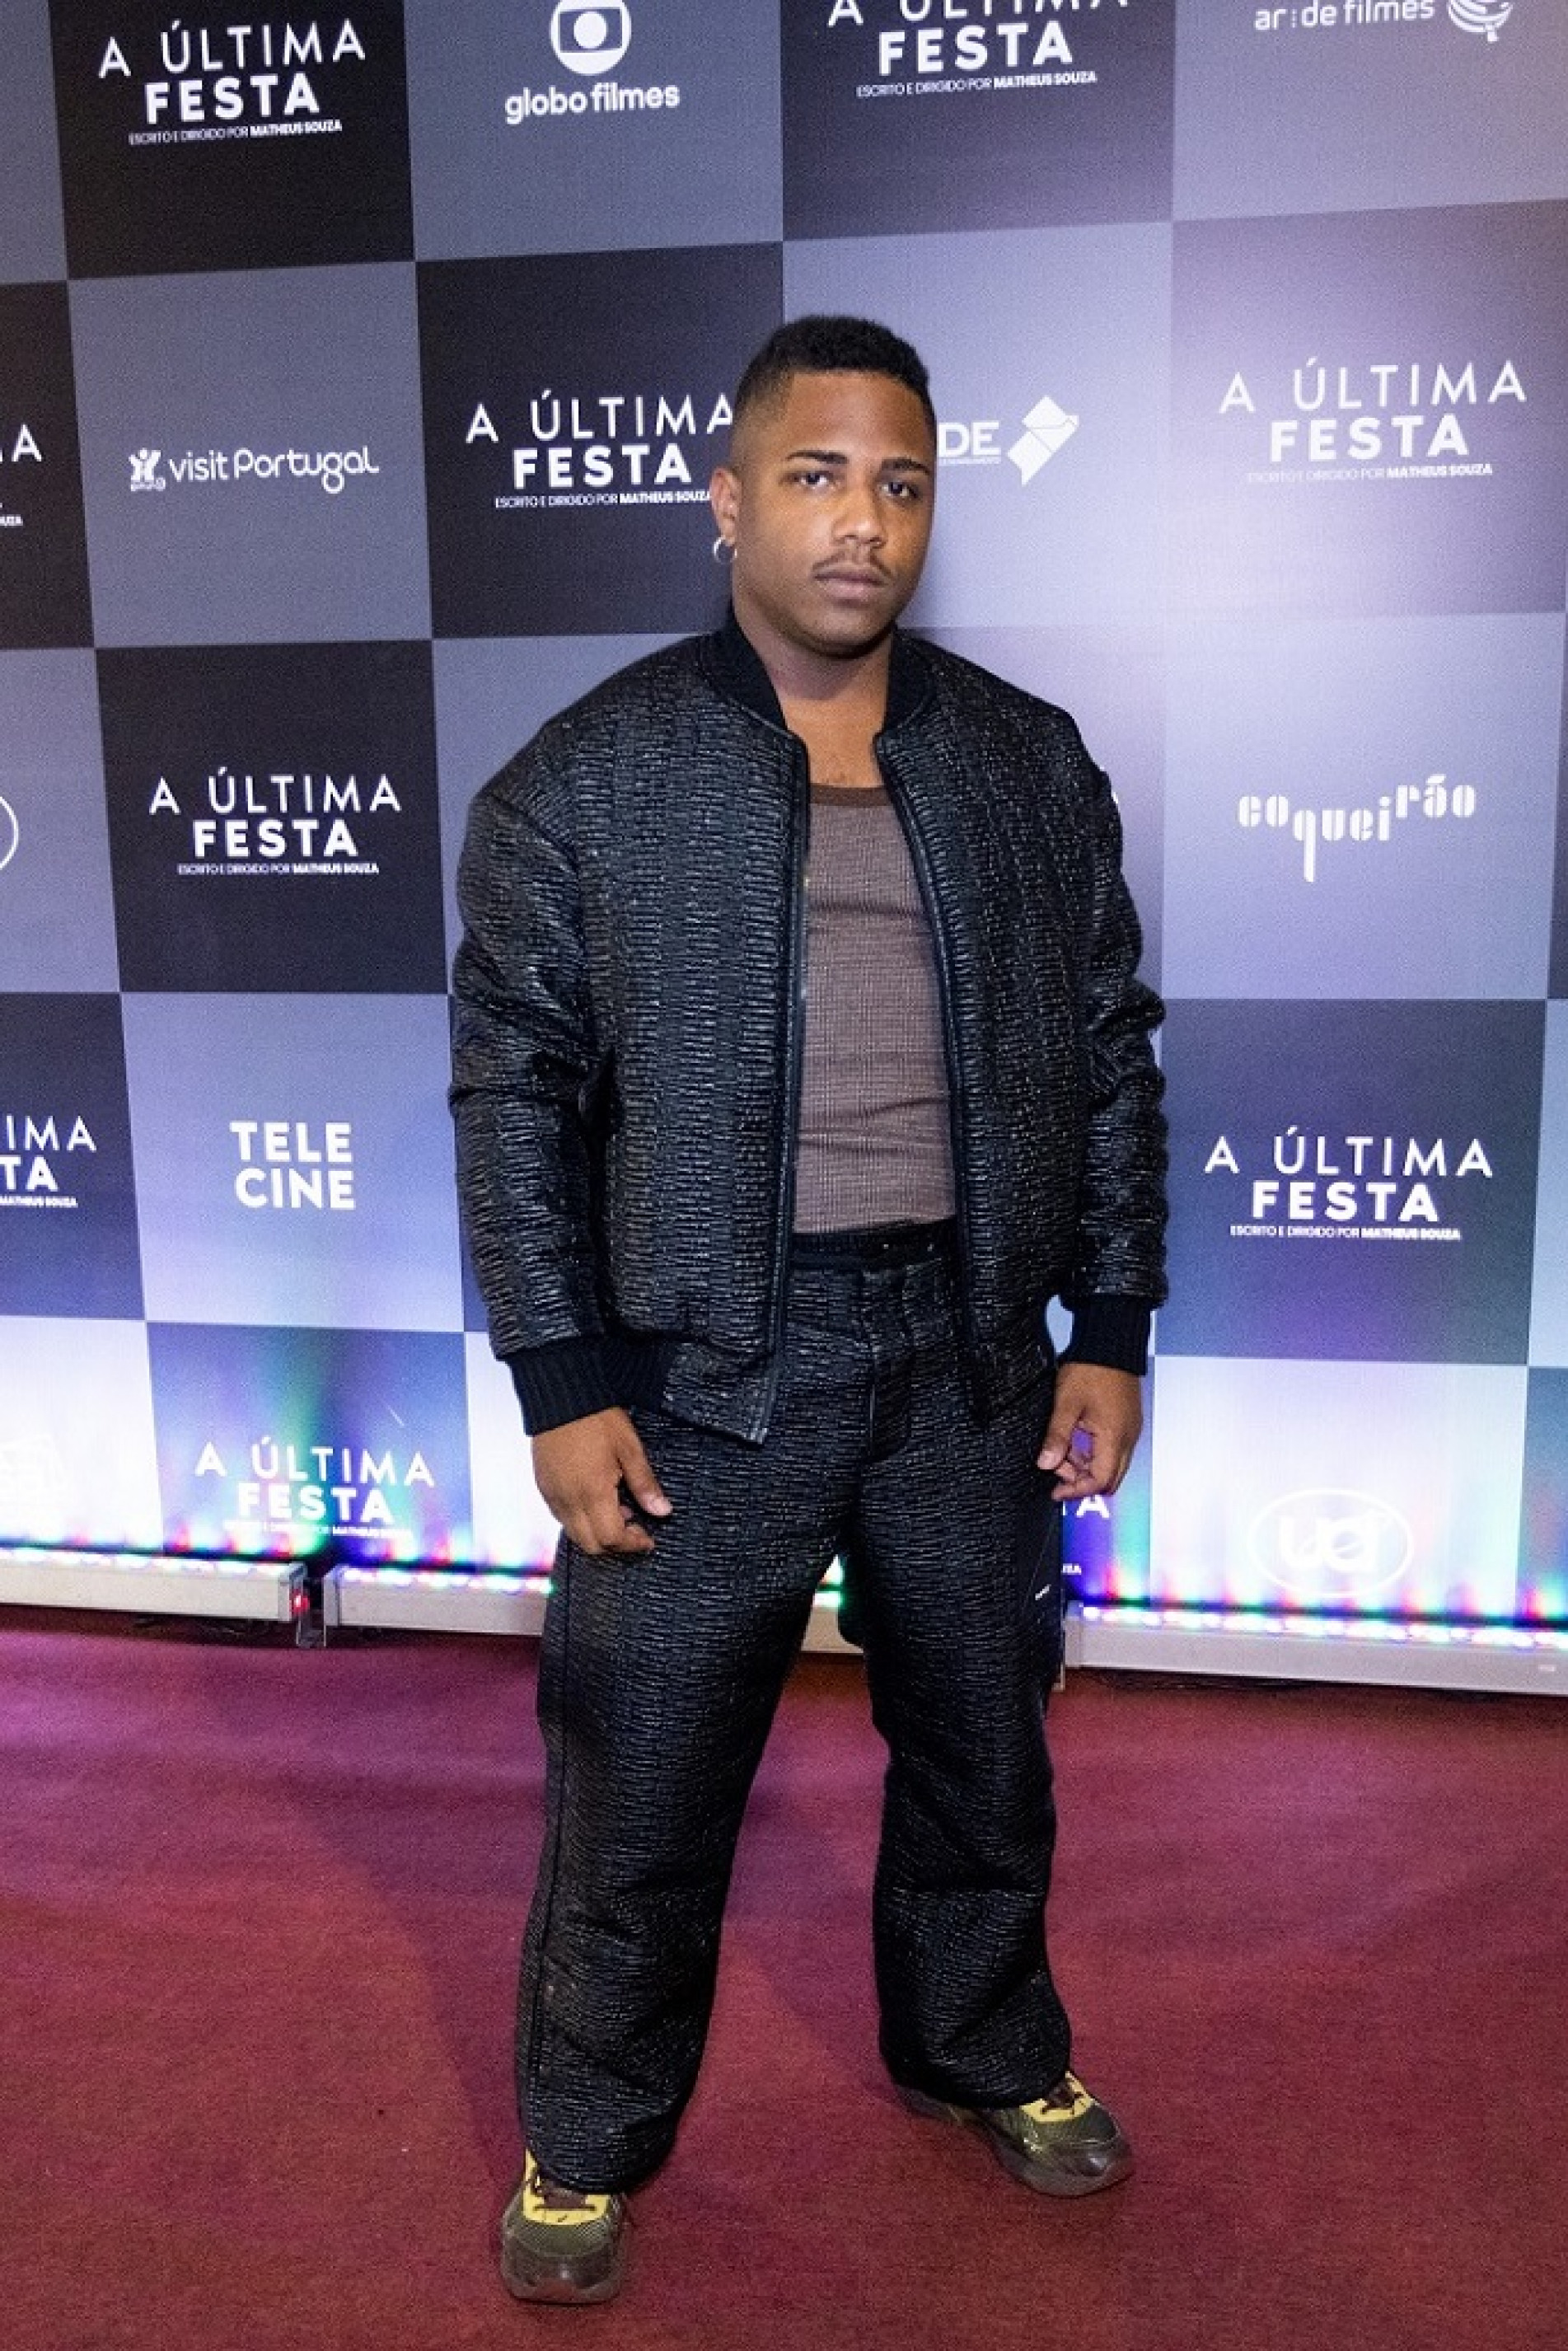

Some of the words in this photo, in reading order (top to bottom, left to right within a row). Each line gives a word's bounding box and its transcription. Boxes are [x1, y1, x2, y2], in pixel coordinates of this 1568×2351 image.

[1345, 0, 1435, 25] filmes
[99, 37, 131, 78] A
[161, 20, 365, 74] ÚLTIMA
[879, 20, 1074, 77] FESTA
[145, 73, 321, 124] FESTA
[505, 87, 587, 124] globo
[590, 82, 680, 112] filmes
[969, 77, 992, 91] POR
[994, 73, 1052, 89] MATHEUS
[1054, 71, 1098, 85] SOUZA
[227, 126, 248, 138] POR
[250, 122, 303, 137] MATHEUS
[305, 119, 342, 133] SOUZA
[1219, 372, 1256, 414] A
[1293, 356, 1527, 411] ÚLTIMA
[466, 402, 498, 443] A
[531, 389, 733, 441] ÚLTIMA
[1270, 413, 1468, 462] FESTA
[938, 419, 1001, 458] DE
[169, 450, 228, 482] visit
[234, 446, 379, 494] Portugal
[513, 443, 691, 489] FESTA
[597, 493, 618, 505] POR
[620, 491, 673, 503] MATHEUS
[149, 777, 180, 815] A
[208, 767, 401, 813] ÚLTIMA
[193, 819, 358, 858] FESTA
[1238, 774, 1477, 883] coqueirão
[7, 1115, 96, 1151] IMA
[230, 1122, 353, 1163] TELE
[1205, 1136, 1239, 1173] A
[1274, 1126, 1493, 1178] ÚLTIMA
[235, 1168, 356, 1210] CINE
[1252, 1180, 1439, 1222] FESTA
[195, 1441, 227, 1477] A
[250, 1435, 435, 1487] ÚLTIMA
[237, 1483, 395, 1524] FESTA
